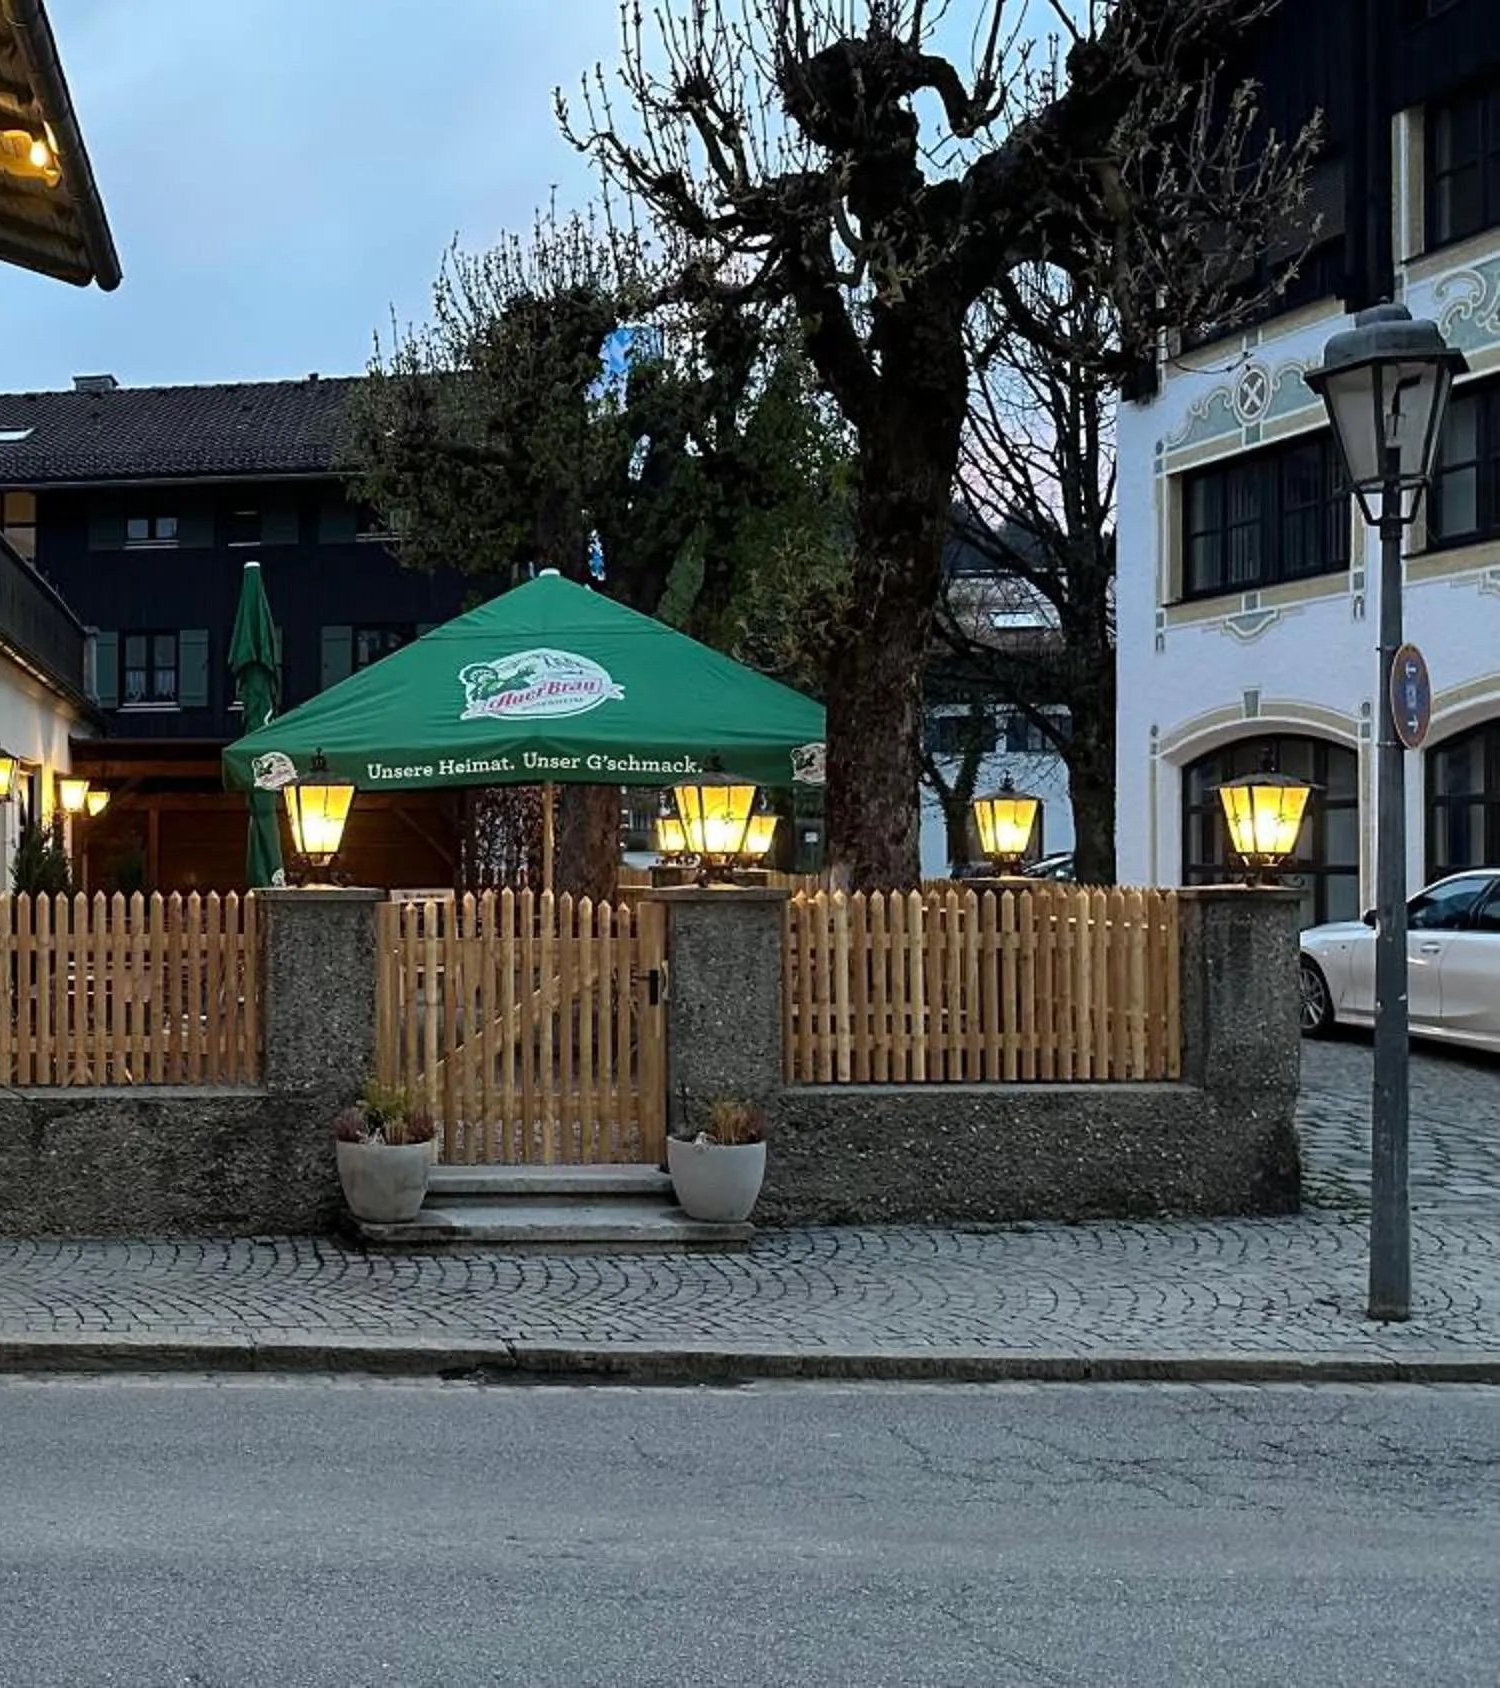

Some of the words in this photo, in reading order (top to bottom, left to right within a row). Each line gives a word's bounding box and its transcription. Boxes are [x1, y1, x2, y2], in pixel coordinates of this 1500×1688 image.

[367, 763, 434, 780] Unsere
[438, 758, 516, 776] Heimat.
[522, 751, 581, 770] Unser
